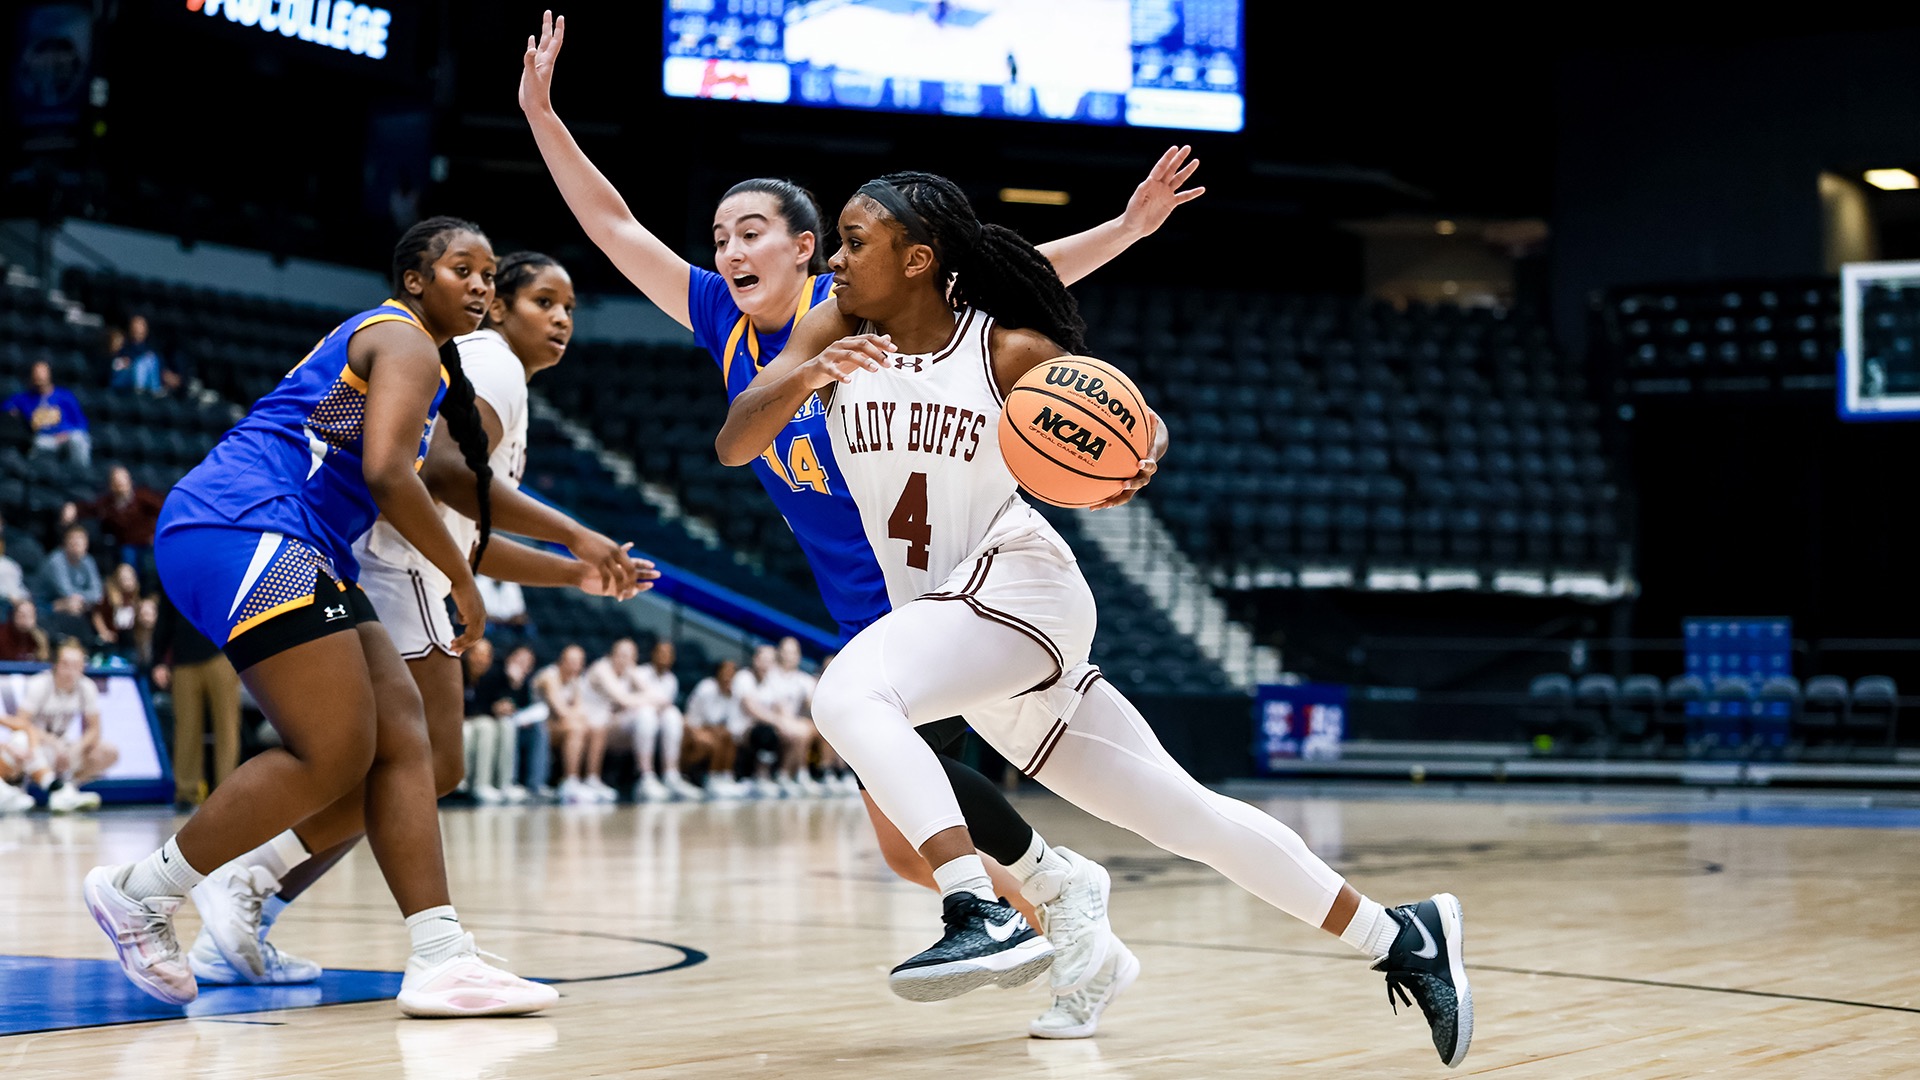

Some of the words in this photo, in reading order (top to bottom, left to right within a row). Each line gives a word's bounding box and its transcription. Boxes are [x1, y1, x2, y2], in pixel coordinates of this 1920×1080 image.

[1045, 366, 1136, 433] Wilson
[841, 401, 896, 454] LADY
[908, 402, 986, 462] BUFFS
[1028, 425, 1056, 445] OFFICIAL
[1078, 454, 1095, 467] BALL
[1031, 405, 1107, 461] NCAA
[760, 434, 833, 496] 14
[888, 471, 932, 572] 4
